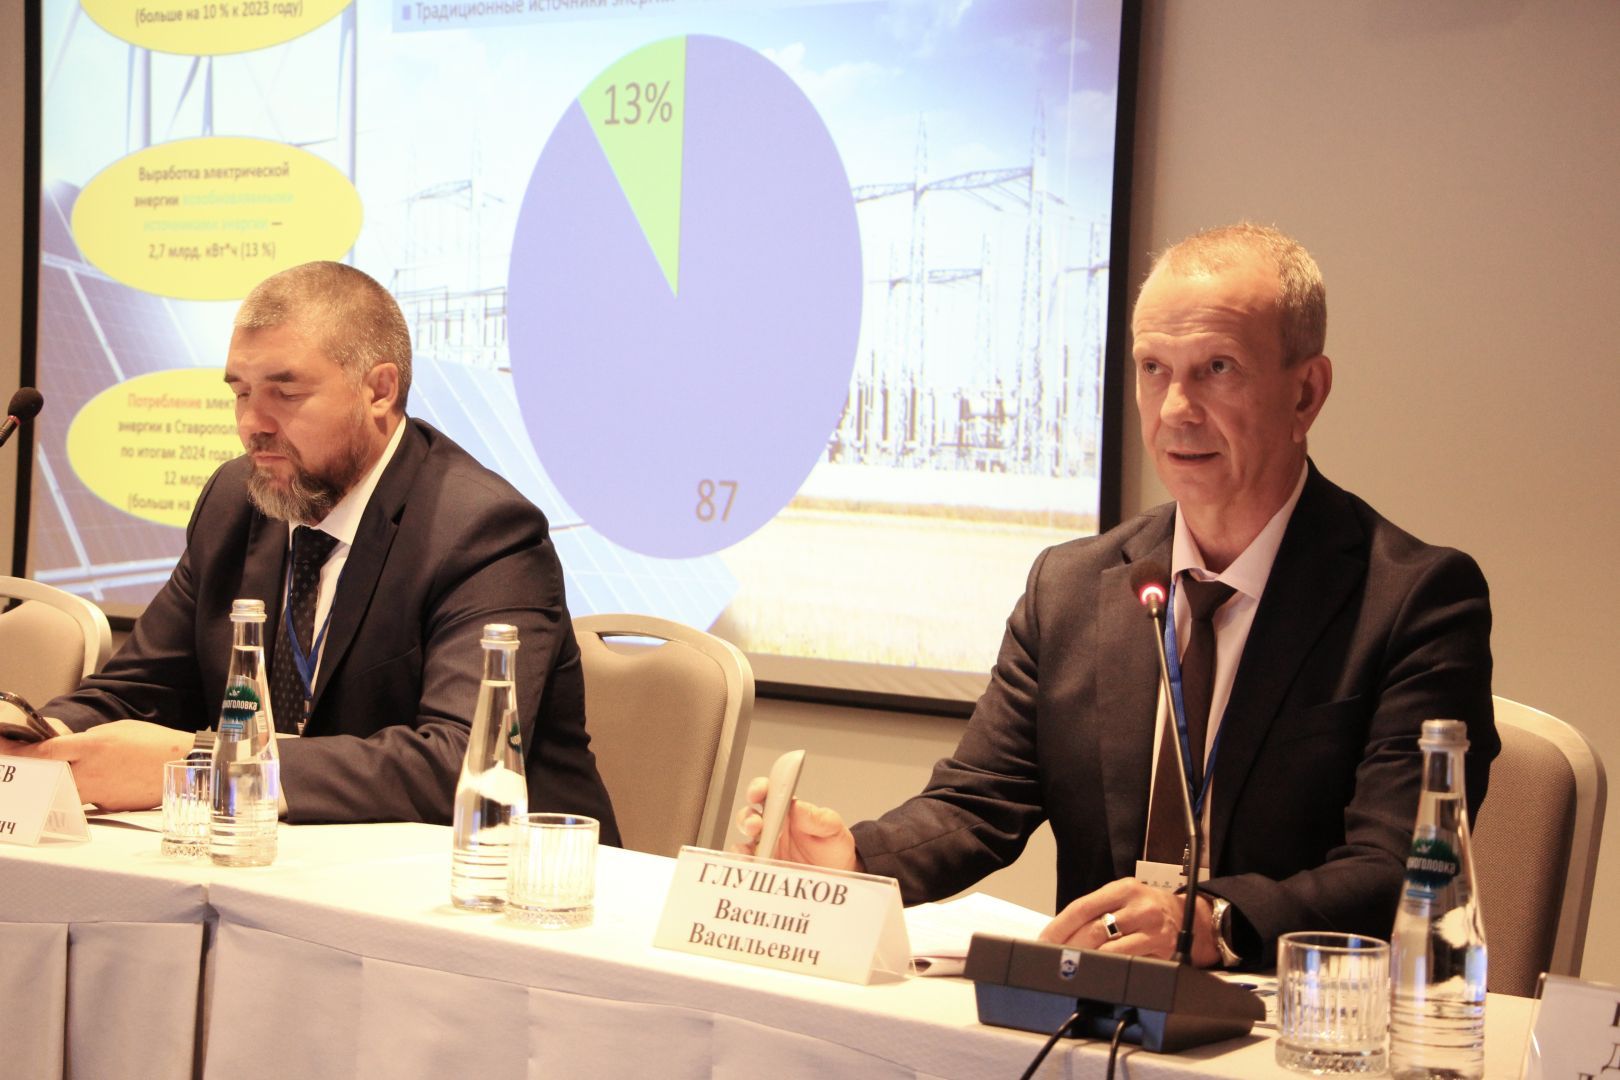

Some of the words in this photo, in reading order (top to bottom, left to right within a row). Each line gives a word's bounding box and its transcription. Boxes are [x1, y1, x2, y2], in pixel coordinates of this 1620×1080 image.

[135, 8, 183, 27] (больше
[186, 9, 200, 20] на
[203, 5, 217, 20] 10
[219, 4, 229, 18] %
[232, 6, 239, 17] к
[242, 1, 270, 17] 2023
[273, 0, 304, 18] году)
[416, 0, 525, 24] Традиционные
[604, 80, 673, 125] 13%
[139, 165, 200, 183] Выработка
[203, 161, 290, 181] электрической
[134, 196, 179, 209] энергии
[149, 243, 166, 260] 2,7
[168, 246, 201, 260] млрд.
[241, 242, 259, 260] (13
[262, 242, 277, 261] %)
[128, 394, 201, 410] Потребление
[118, 422, 162, 435] энергии
[166, 423, 172, 433] в
[120, 447, 134, 458] по
[138, 447, 176, 459] итогам
[179, 446, 205, 460] 2024
[165, 471, 176, 485] 12
[128, 493, 174, 511] (больше
[178, 500, 190, 511] на
[696, 479, 738, 522] 87
[698, 862, 849, 905] ГЛУШАКОВ
[714, 898, 811, 934] Василий
[688, 922, 821, 966] Васильевич
